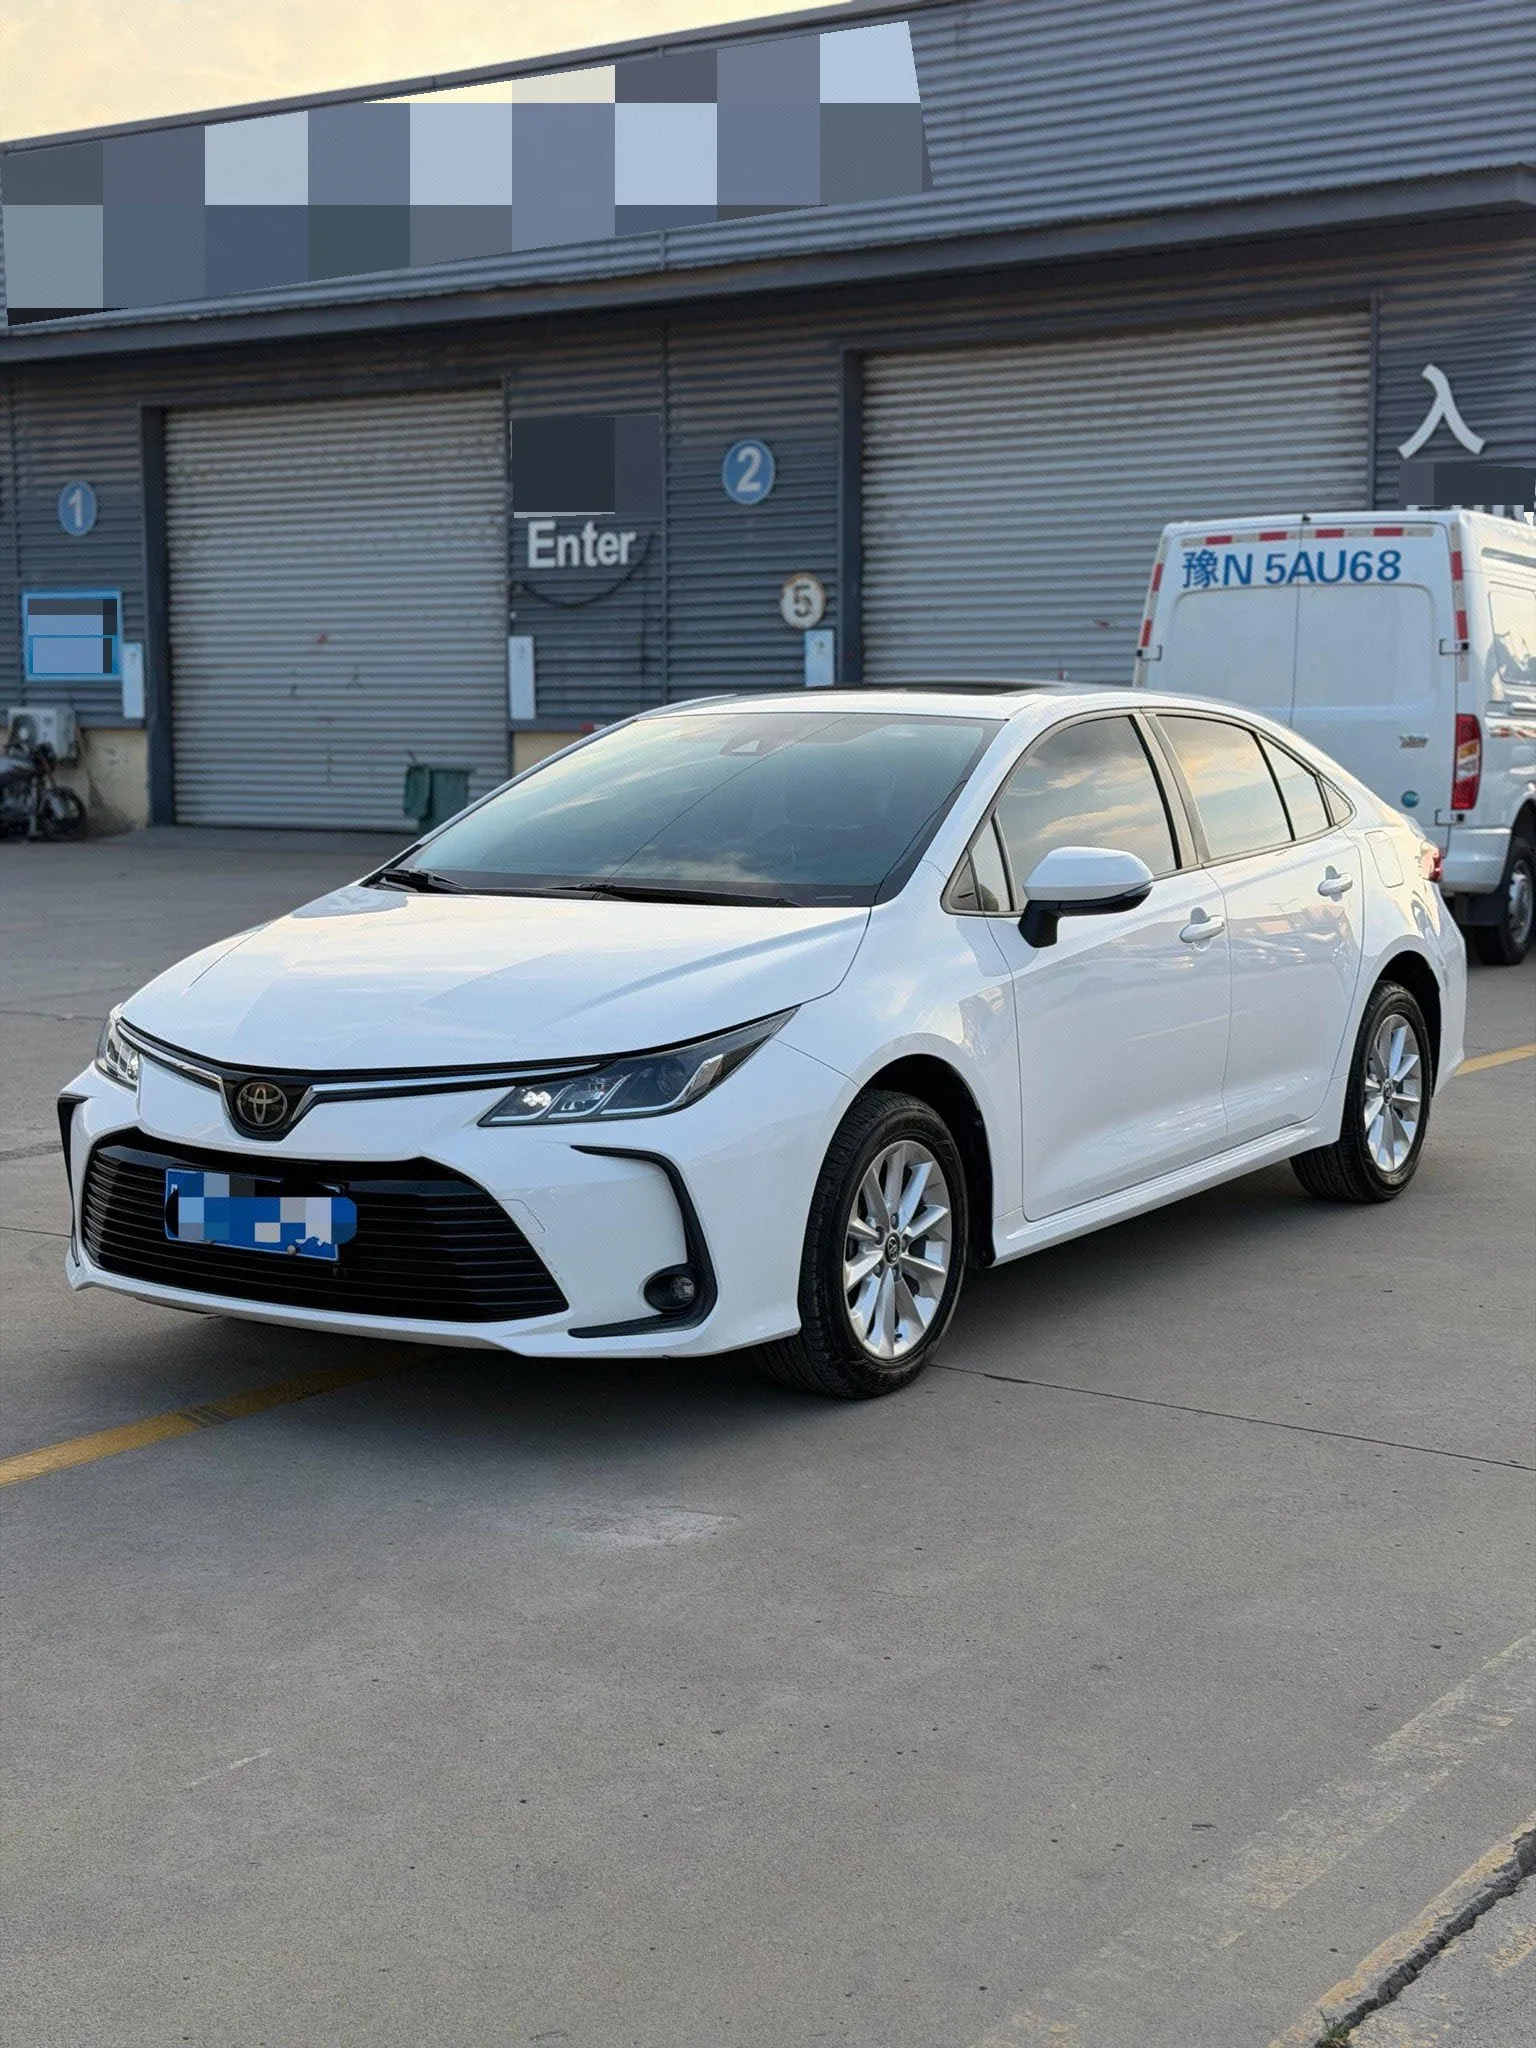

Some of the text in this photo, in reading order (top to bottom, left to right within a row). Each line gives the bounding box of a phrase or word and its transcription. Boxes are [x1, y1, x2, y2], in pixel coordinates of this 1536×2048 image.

[1397, 363, 1486, 460] 入
[736, 448, 760, 493] 2
[67, 487, 84, 528] 1
[527, 519, 637, 569] Enter
[1264, 549, 1402, 585] 5AU68
[792, 584, 813, 618] 5
